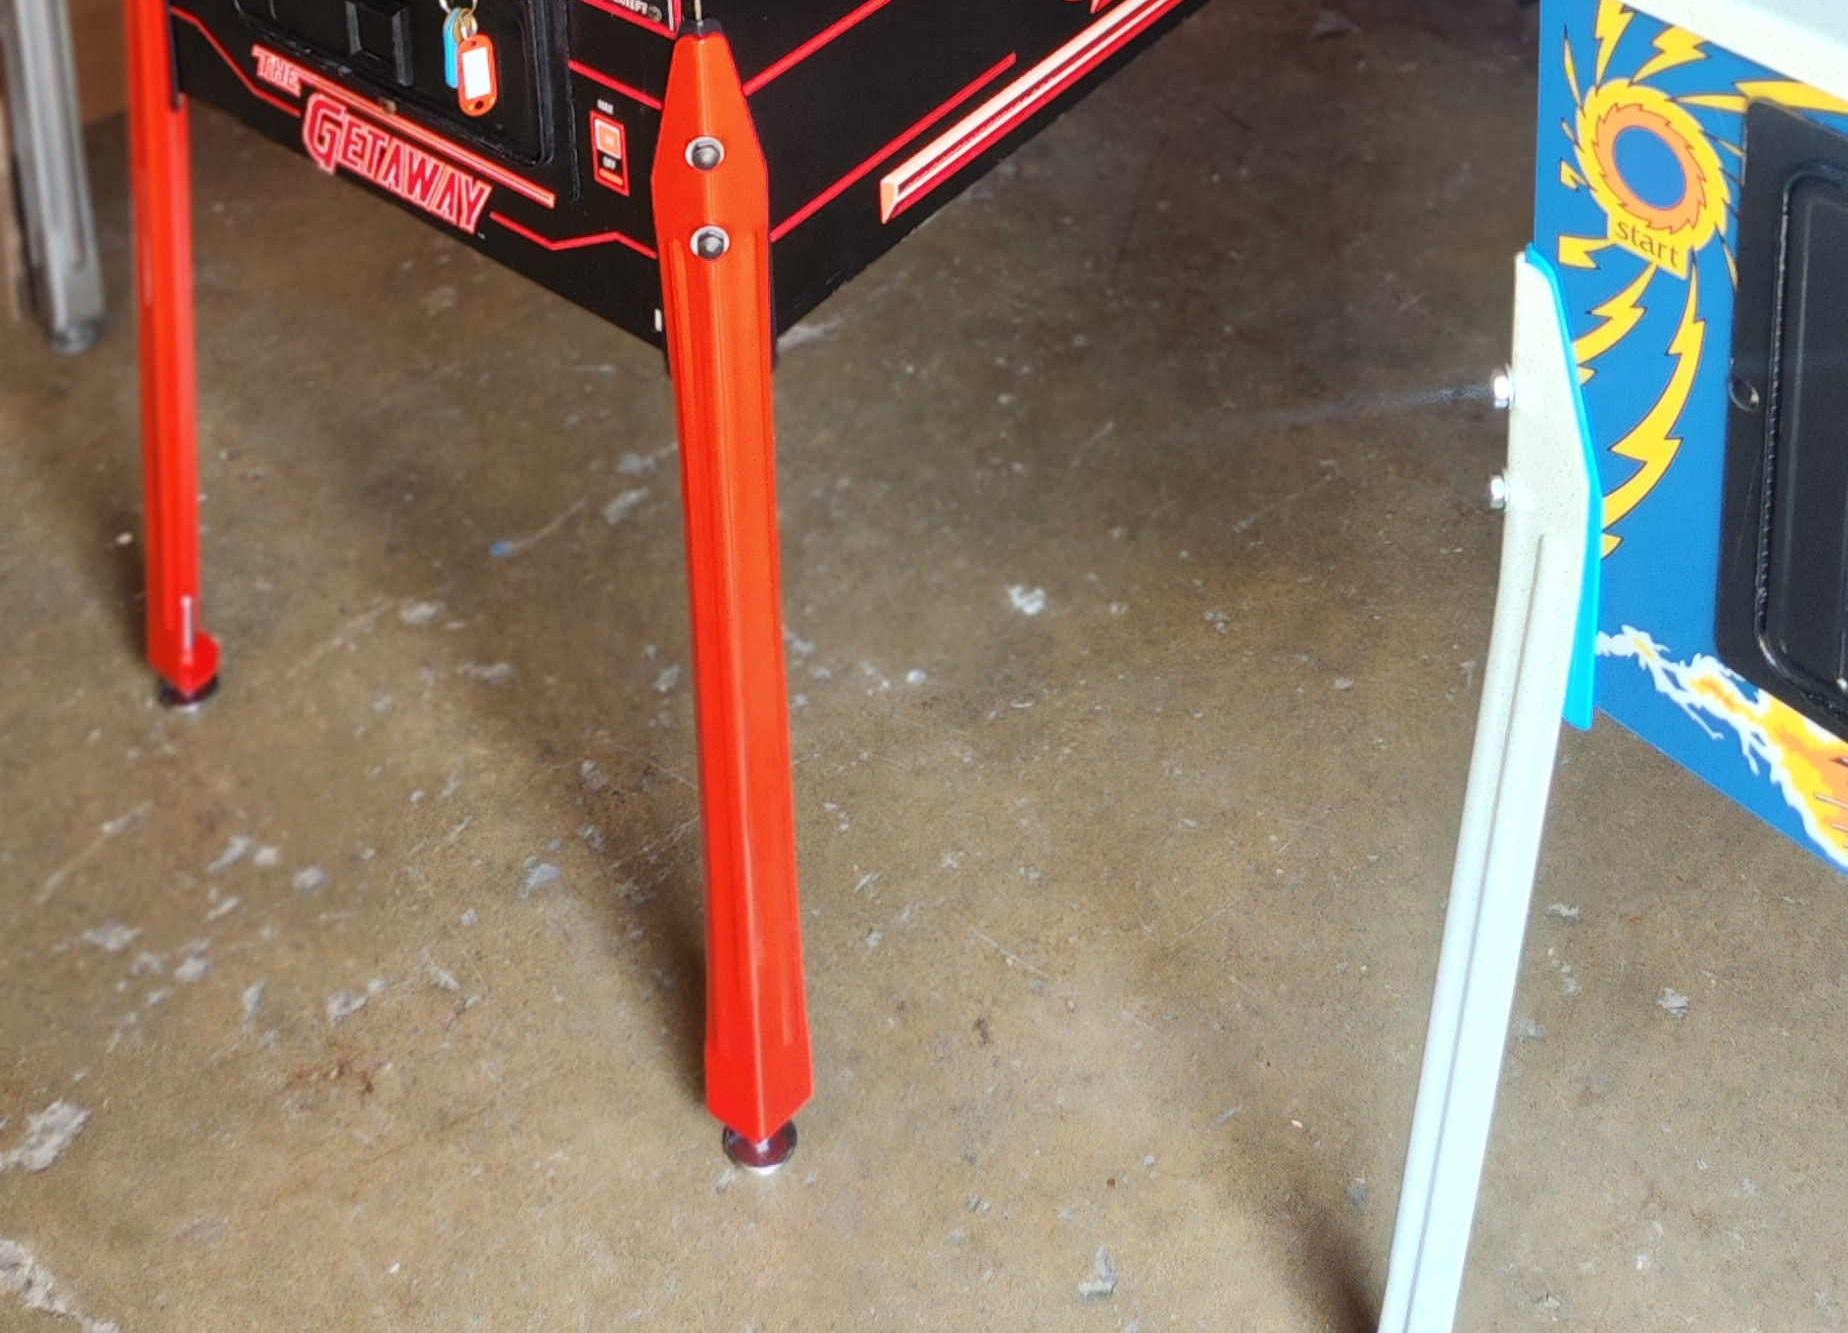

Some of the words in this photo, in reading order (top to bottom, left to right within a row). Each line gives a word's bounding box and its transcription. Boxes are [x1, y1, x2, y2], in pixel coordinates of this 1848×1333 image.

[252, 43, 302, 99] THE
[302, 91, 494, 236] GETAWAY
[1614, 220, 1679, 269] start
